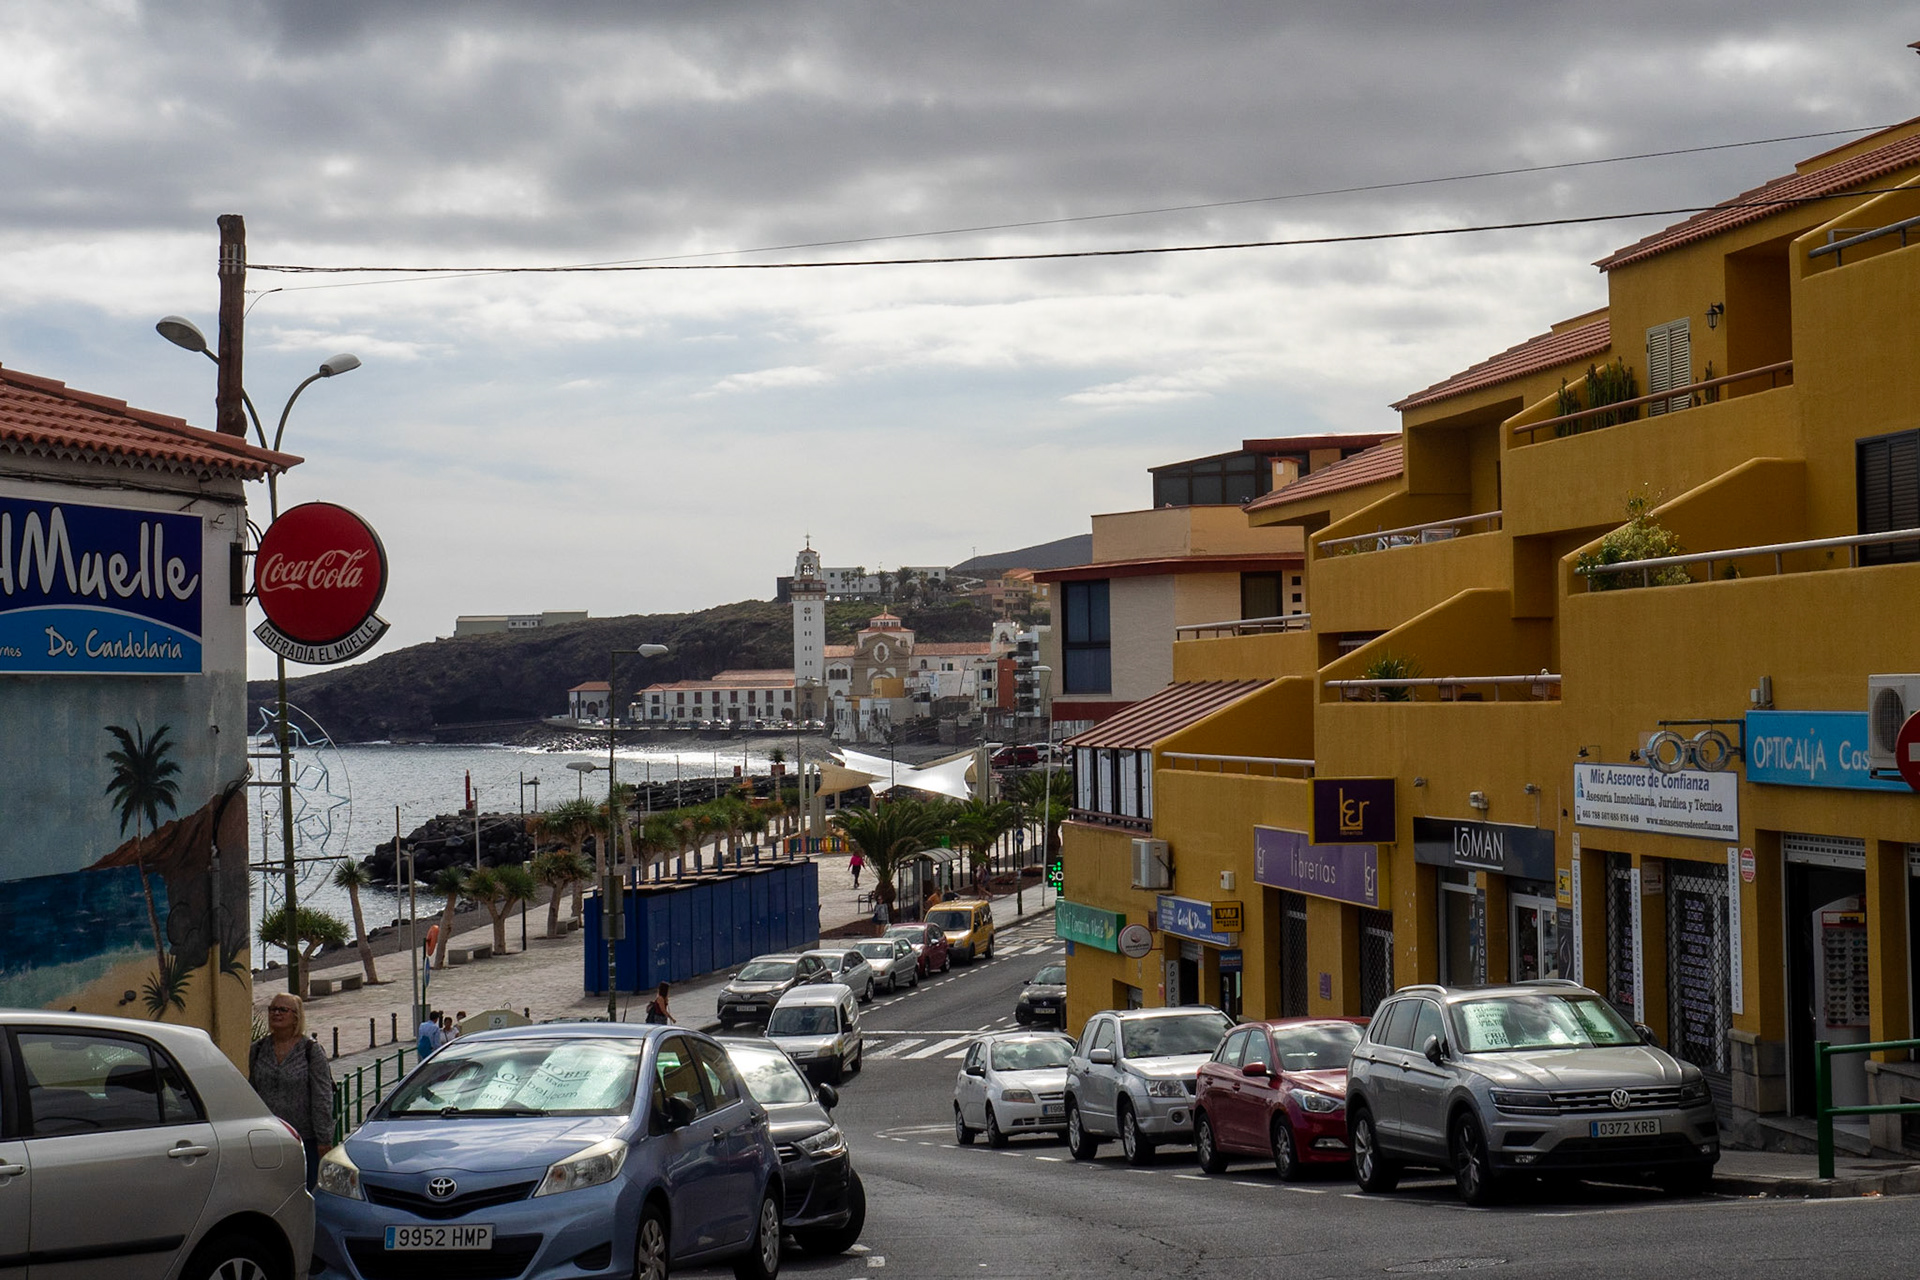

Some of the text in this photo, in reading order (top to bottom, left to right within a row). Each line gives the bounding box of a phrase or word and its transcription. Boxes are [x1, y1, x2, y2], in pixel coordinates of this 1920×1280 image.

[18, 506, 199, 600] Muelle
[261, 549, 371, 592] Coca-Cola
[45, 626, 78, 656] De
[86, 629, 183, 658] Candelaria
[259, 621, 377, 661] COFRADÍA EL MUELLE
[1590, 769, 1710, 791] Mis Asesores de Confianza
[1585, 790, 1613, 803] Asesoría
[1658, 796, 1687, 809] Jurídica
[1688, 801, 1693, 813] y
[1694, 799, 1723, 812] Técnica
[1290, 848, 1336, 884] librerías
[1600, 1121, 1656, 1135] 0372 KRB
[398, 1228, 488, 1247] 9952 HMP
